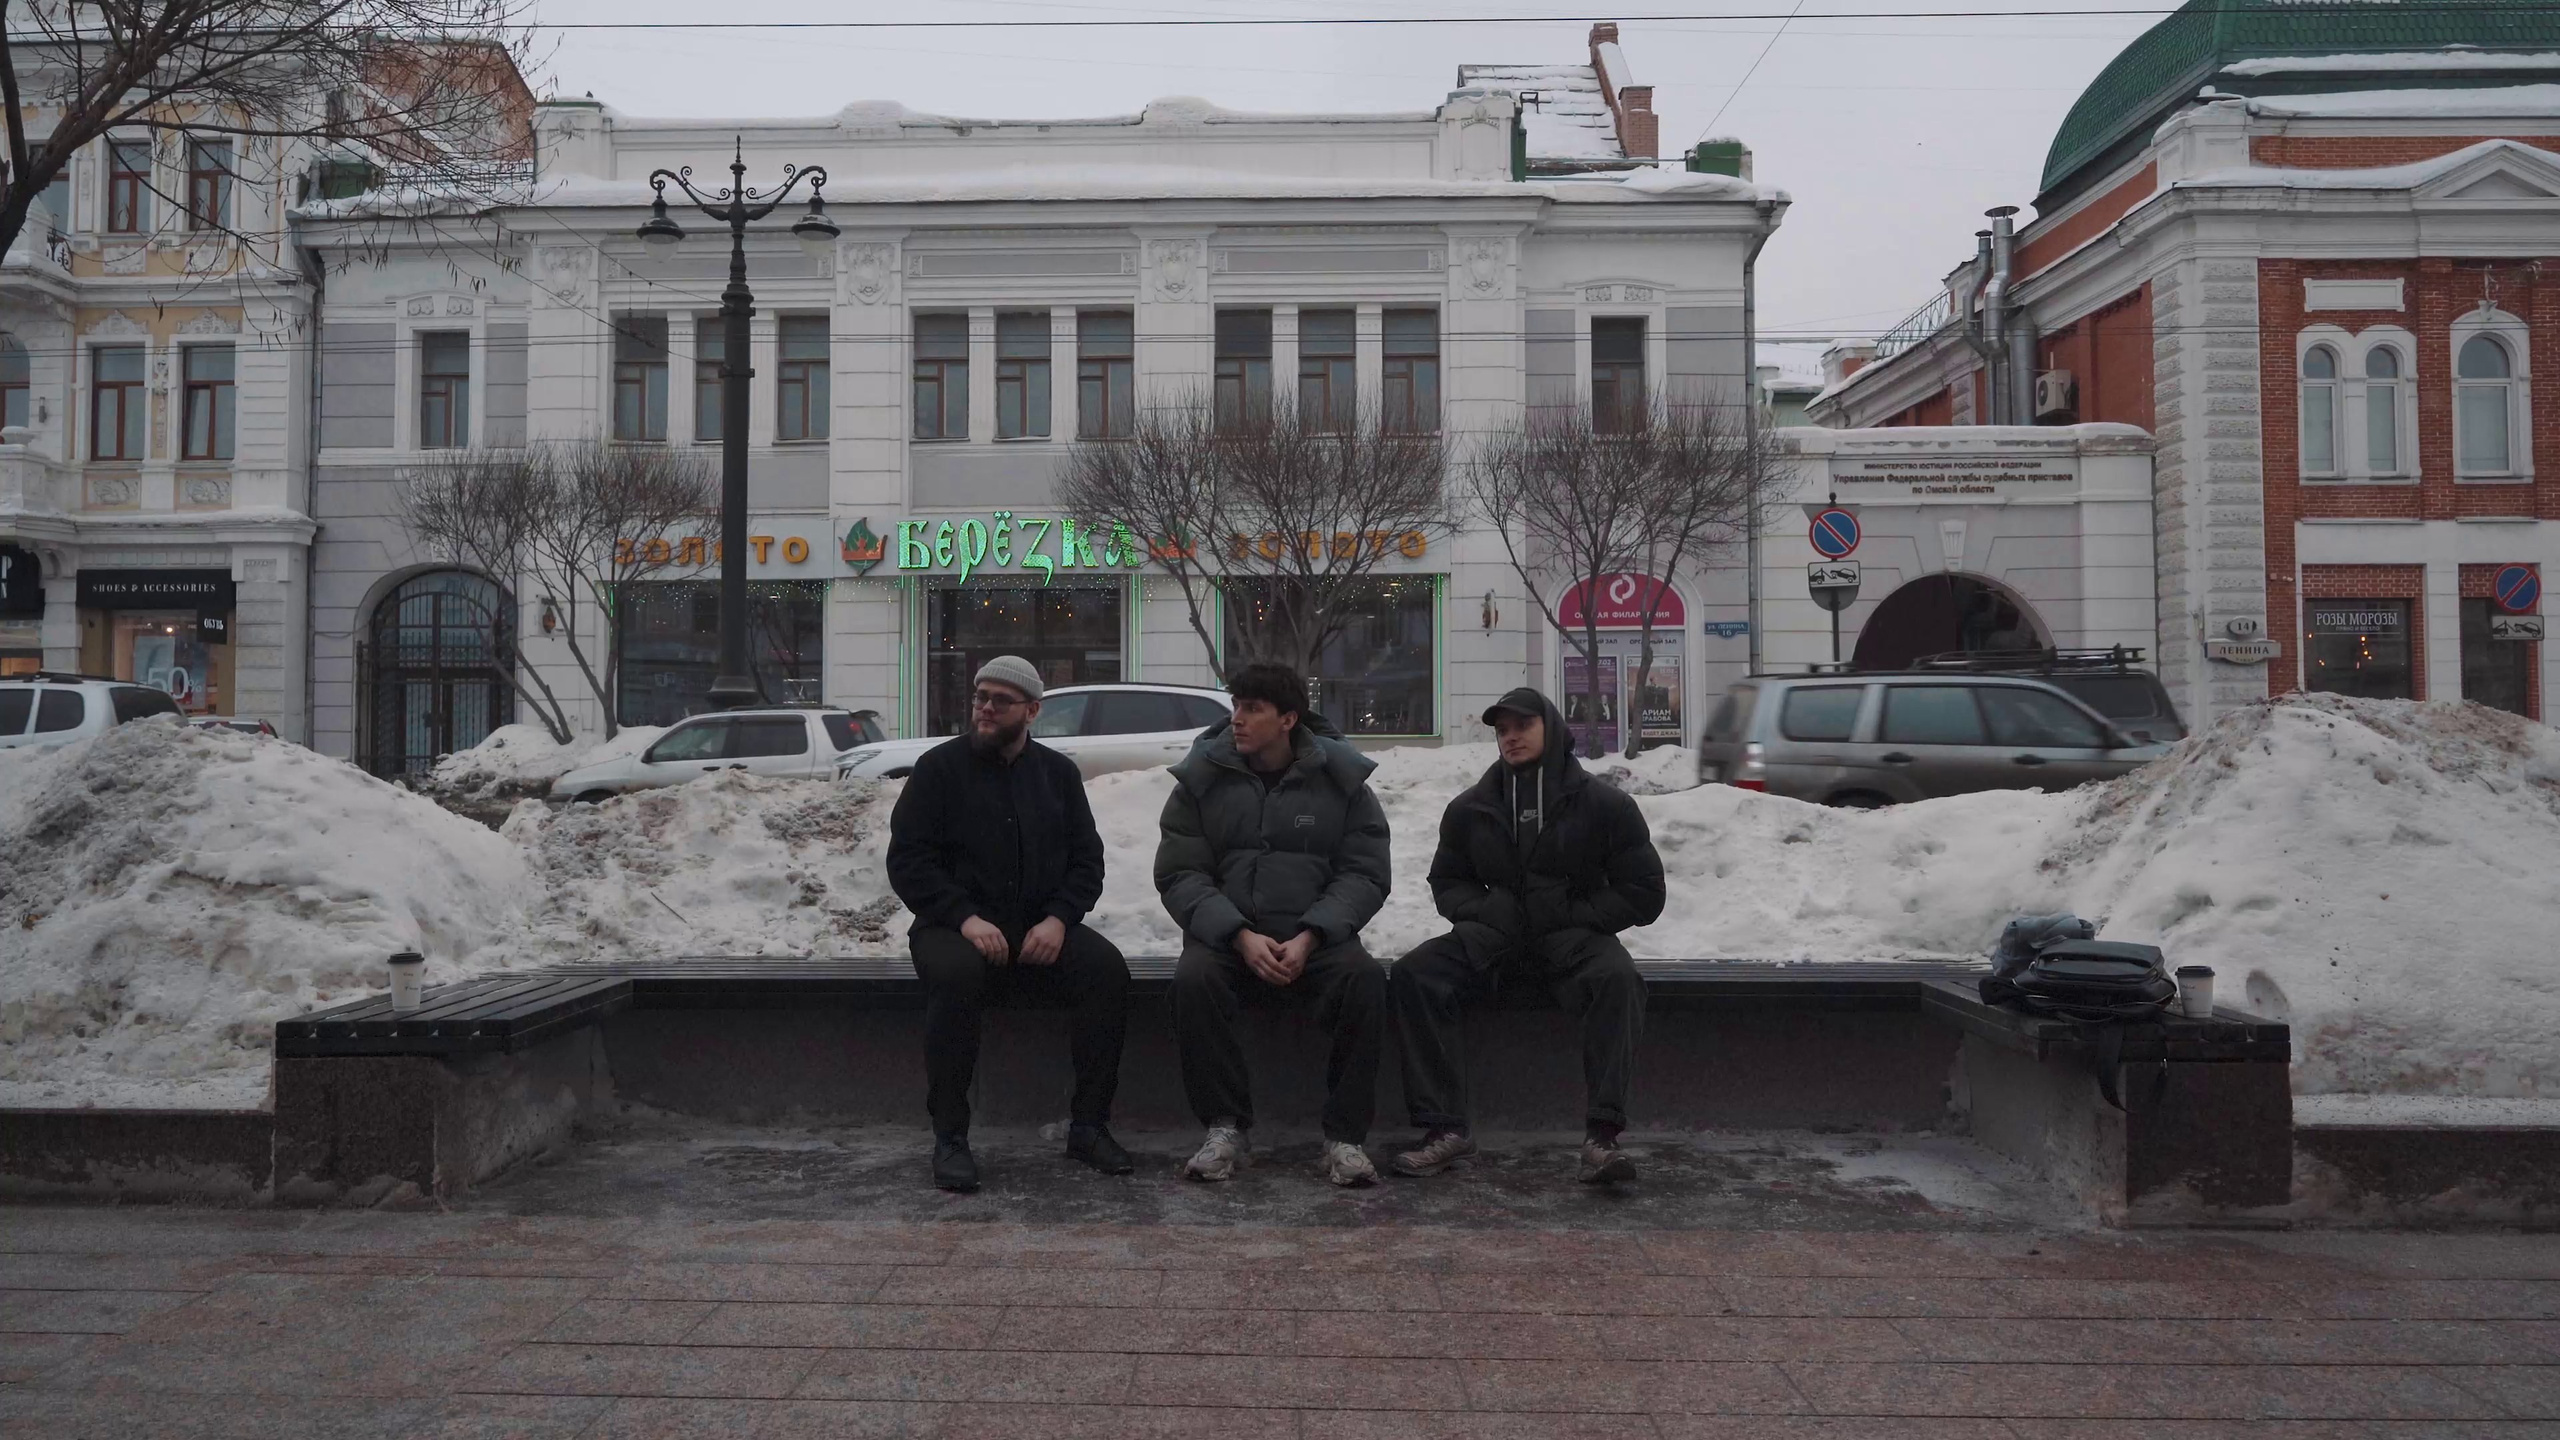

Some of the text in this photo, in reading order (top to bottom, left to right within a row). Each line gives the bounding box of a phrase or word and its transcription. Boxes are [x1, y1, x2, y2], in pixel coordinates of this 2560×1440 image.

[1954, 461, 1999, 469] РОССИЙСКОЙ
[1833, 472, 2073, 484] Управление Федеральной службы судебных приставов
[1912, 485, 1995, 494] по Омской области
[615, 536, 809, 564] ЗОЛТО
[92, 584, 127, 593] SHOES
[142, 583, 216, 593] ACCESSORIES
[2316, 612, 2398, 625] РОЗЫ МОРОЗЫ
[2237, 622, 2249, 631] 14
[2219, 646, 2270, 655] ЛЕНИНА
